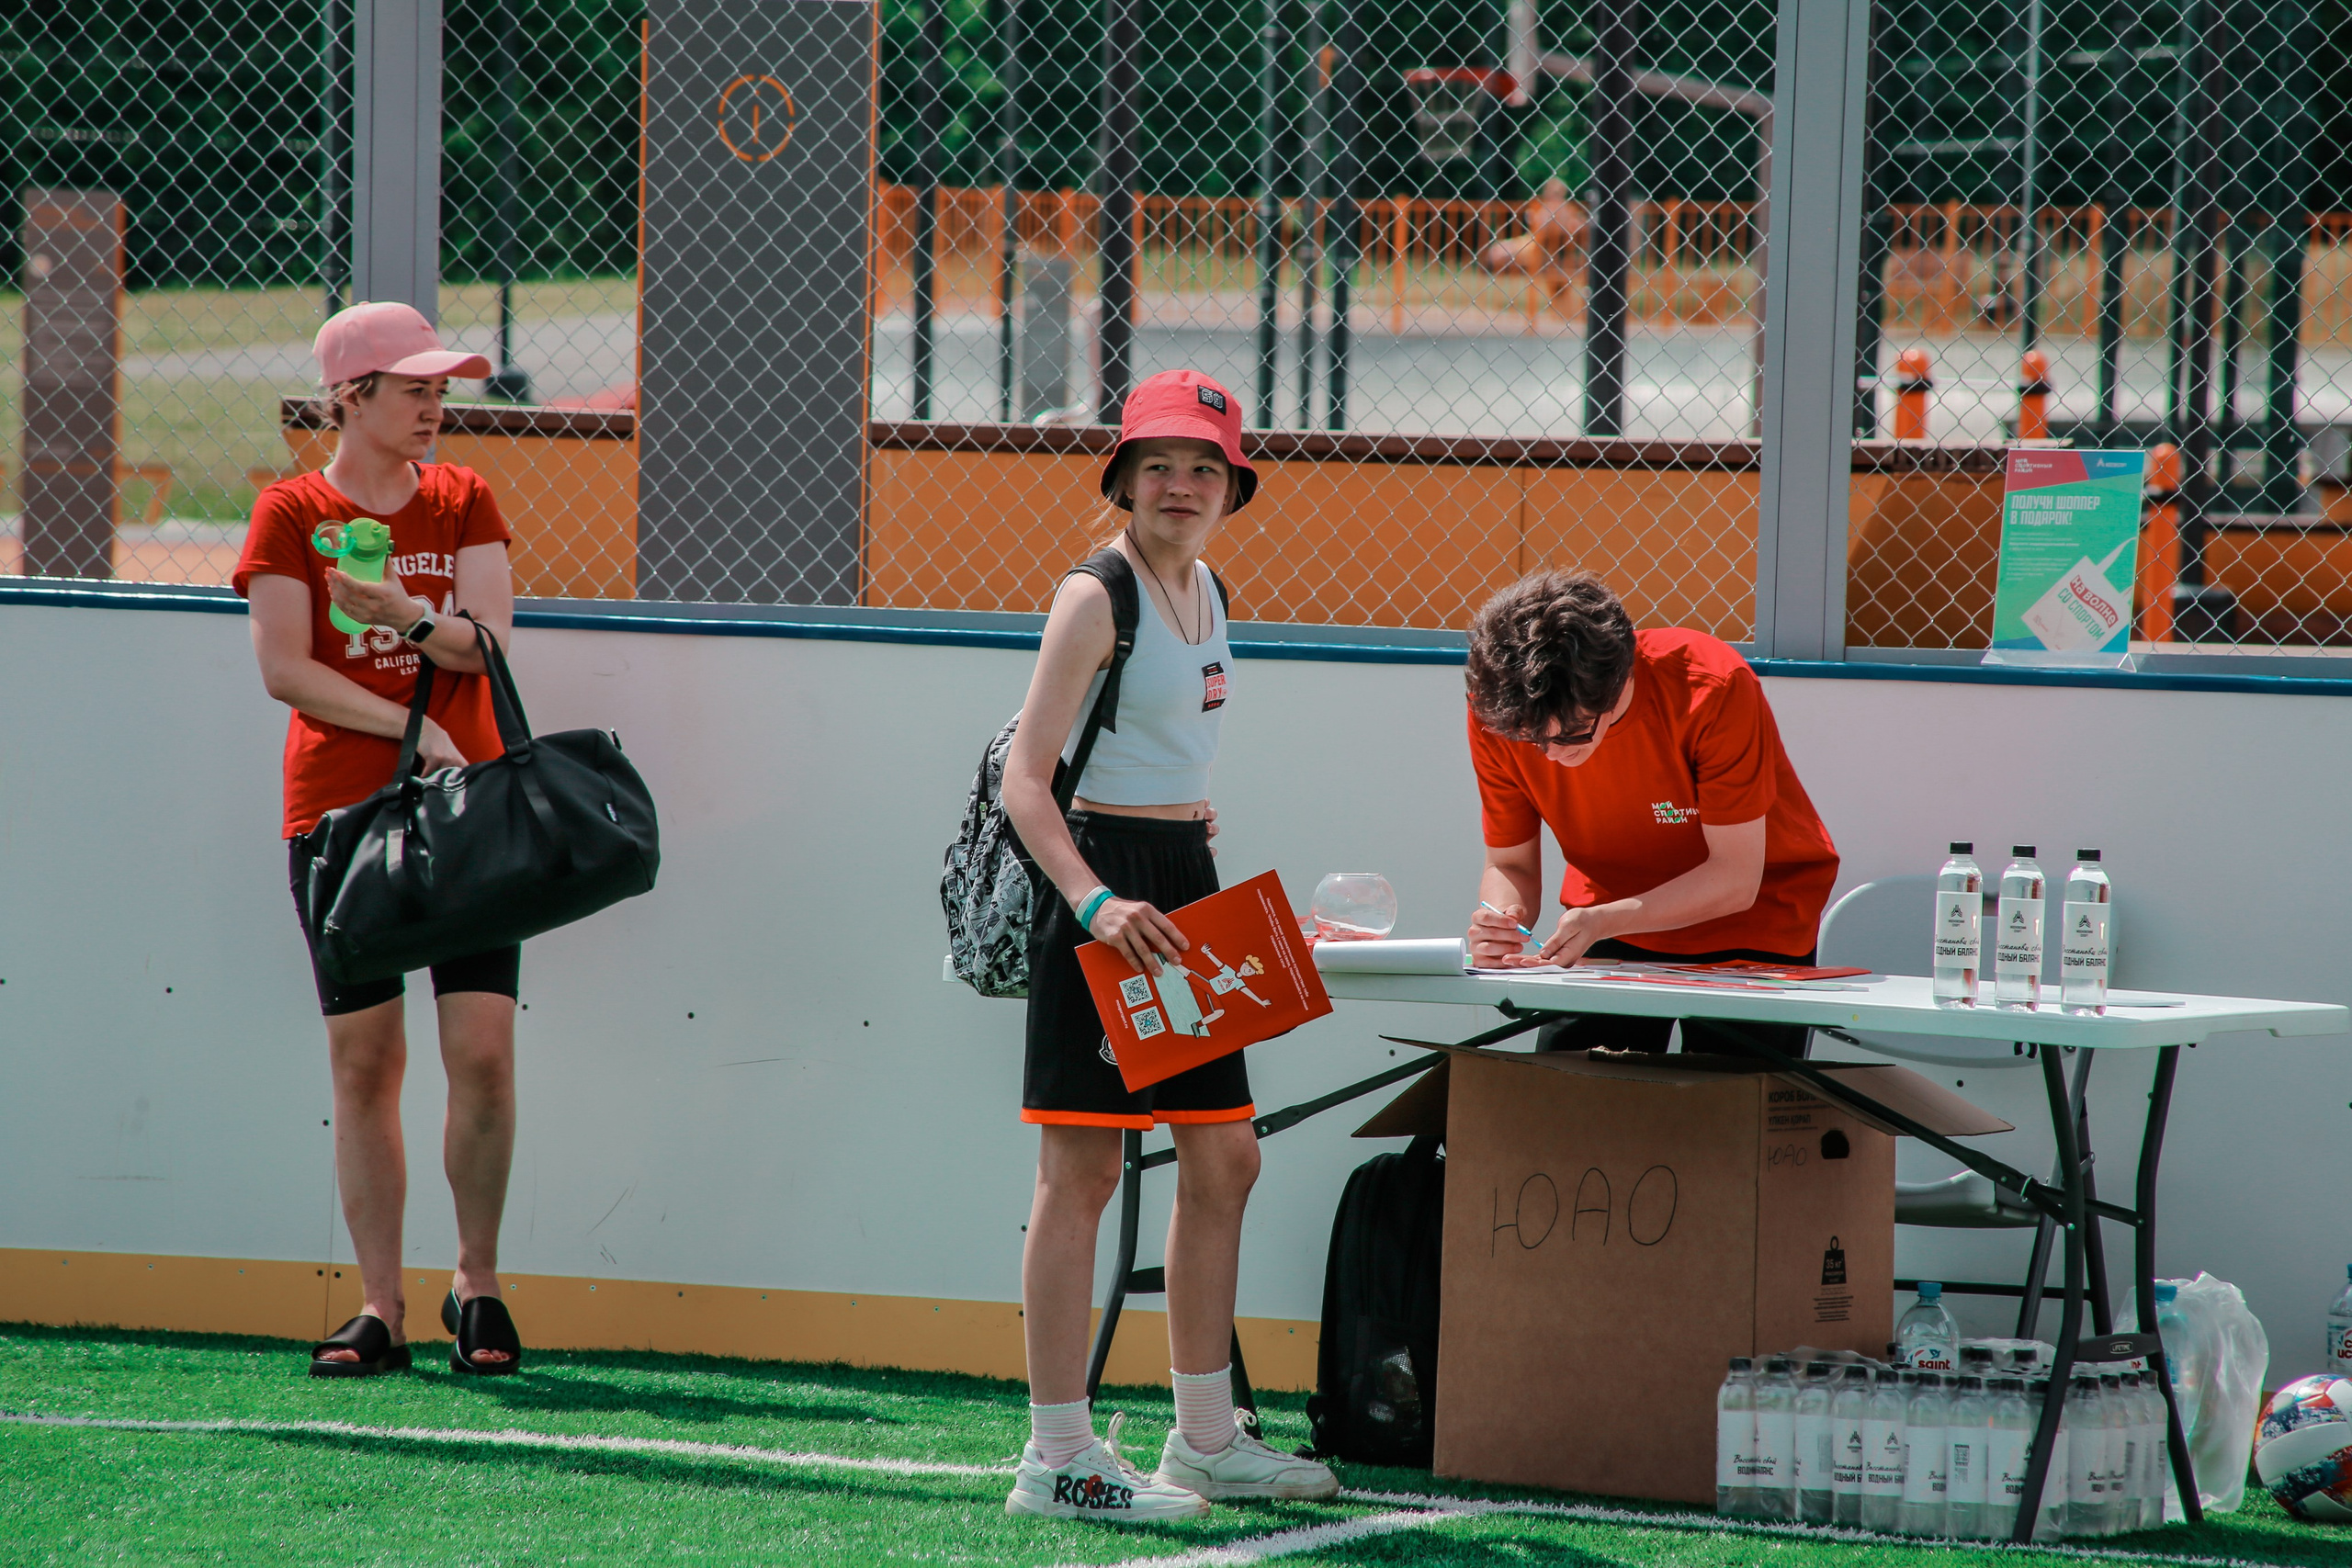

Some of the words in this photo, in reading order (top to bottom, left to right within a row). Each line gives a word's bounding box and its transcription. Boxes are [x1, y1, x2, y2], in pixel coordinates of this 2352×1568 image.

[2011, 494, 2053, 510] ПОЛУЧИ
[2055, 495, 2101, 511] ШОППЕР
[2009, 510, 2018, 525] В
[2019, 511, 2073, 526] ПОДАРОК!
[2057, 587, 2074, 604] СО
[2067, 599, 2106, 641] СПОРТОМ
[375, 653, 421, 670] CALIFOR
[1206, 674, 1227, 689] SUPER
[1207, 687, 1222, 702] DRY
[1651, 801, 1673, 810] МОЙ
[1292, 963, 1305, 987] путешествие
[1769, 1090, 1795, 1102] КОРОБ
[1768, 1144, 1807, 1173] ЮАО
[1491, 1165, 1679, 1258] ЮАО
[1826, 1258, 1834, 1269] 35
[1918, 1359, 1951, 1370] saint
[1868, 1473, 1893, 1483] ВОДНЫЙ
[1053, 1473, 1134, 1509] ROSES
